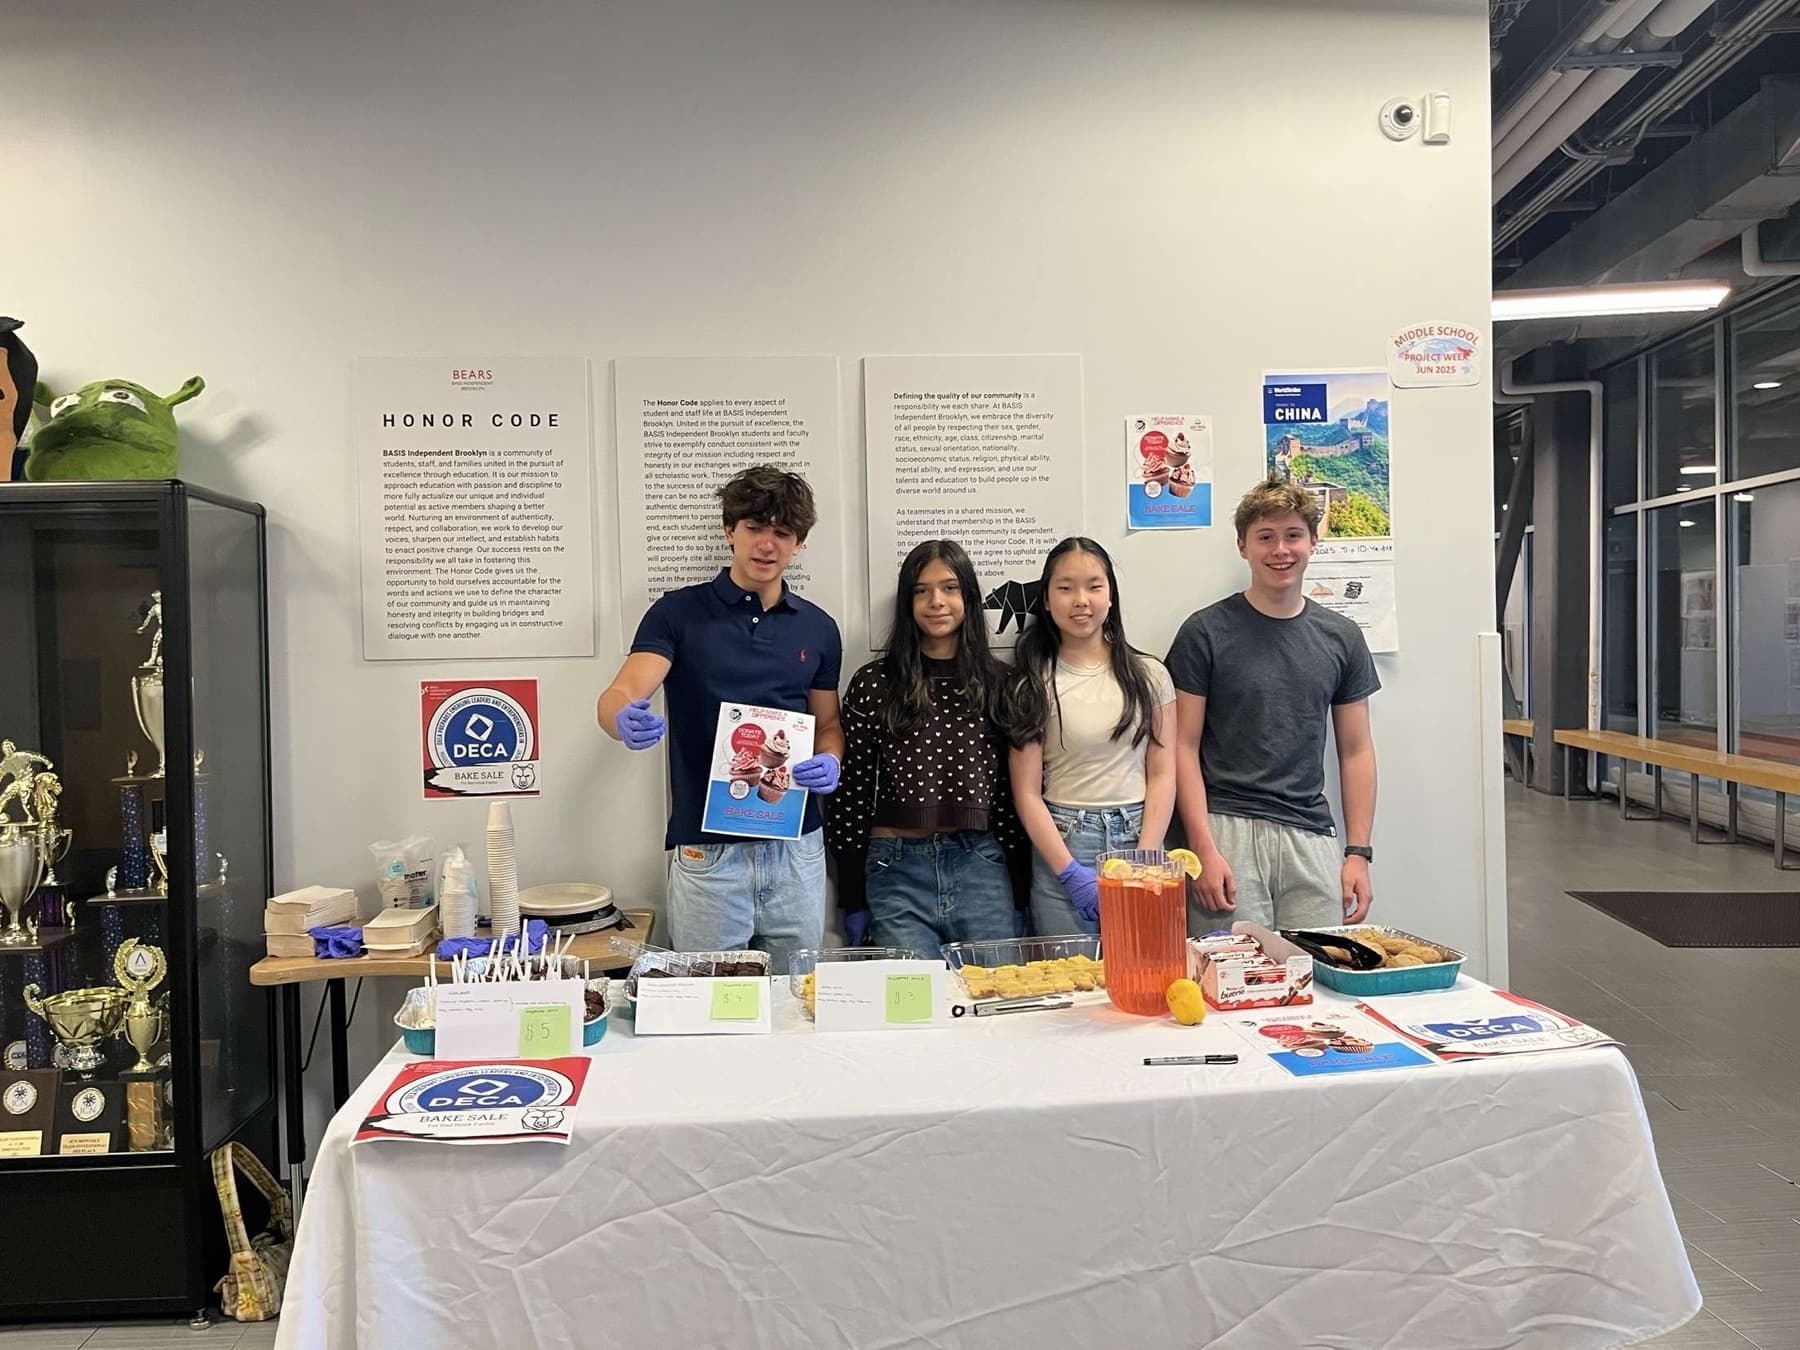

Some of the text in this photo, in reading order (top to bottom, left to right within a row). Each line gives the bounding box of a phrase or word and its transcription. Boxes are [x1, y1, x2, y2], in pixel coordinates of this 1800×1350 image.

[1394, 326, 1479, 347] MIDDLE SCHOOL
[1405, 352, 1468, 361] PROJECT WEEK
[453, 370, 492, 379] BEARS
[1275, 408, 1321, 420] CHINA
[383, 414, 558, 427] HONOR CODE
[454, 744, 508, 758] DECA
[725, 806, 784, 820] BAKE SALE
[1220, 989, 1245, 1000] bueno
[1447, 1023, 1534, 1037] DECA
[1472, 1040, 1509, 1048] BAKE
[429, 1095, 523, 1107] DECA
[419, 1115, 464, 1123] BAKE
